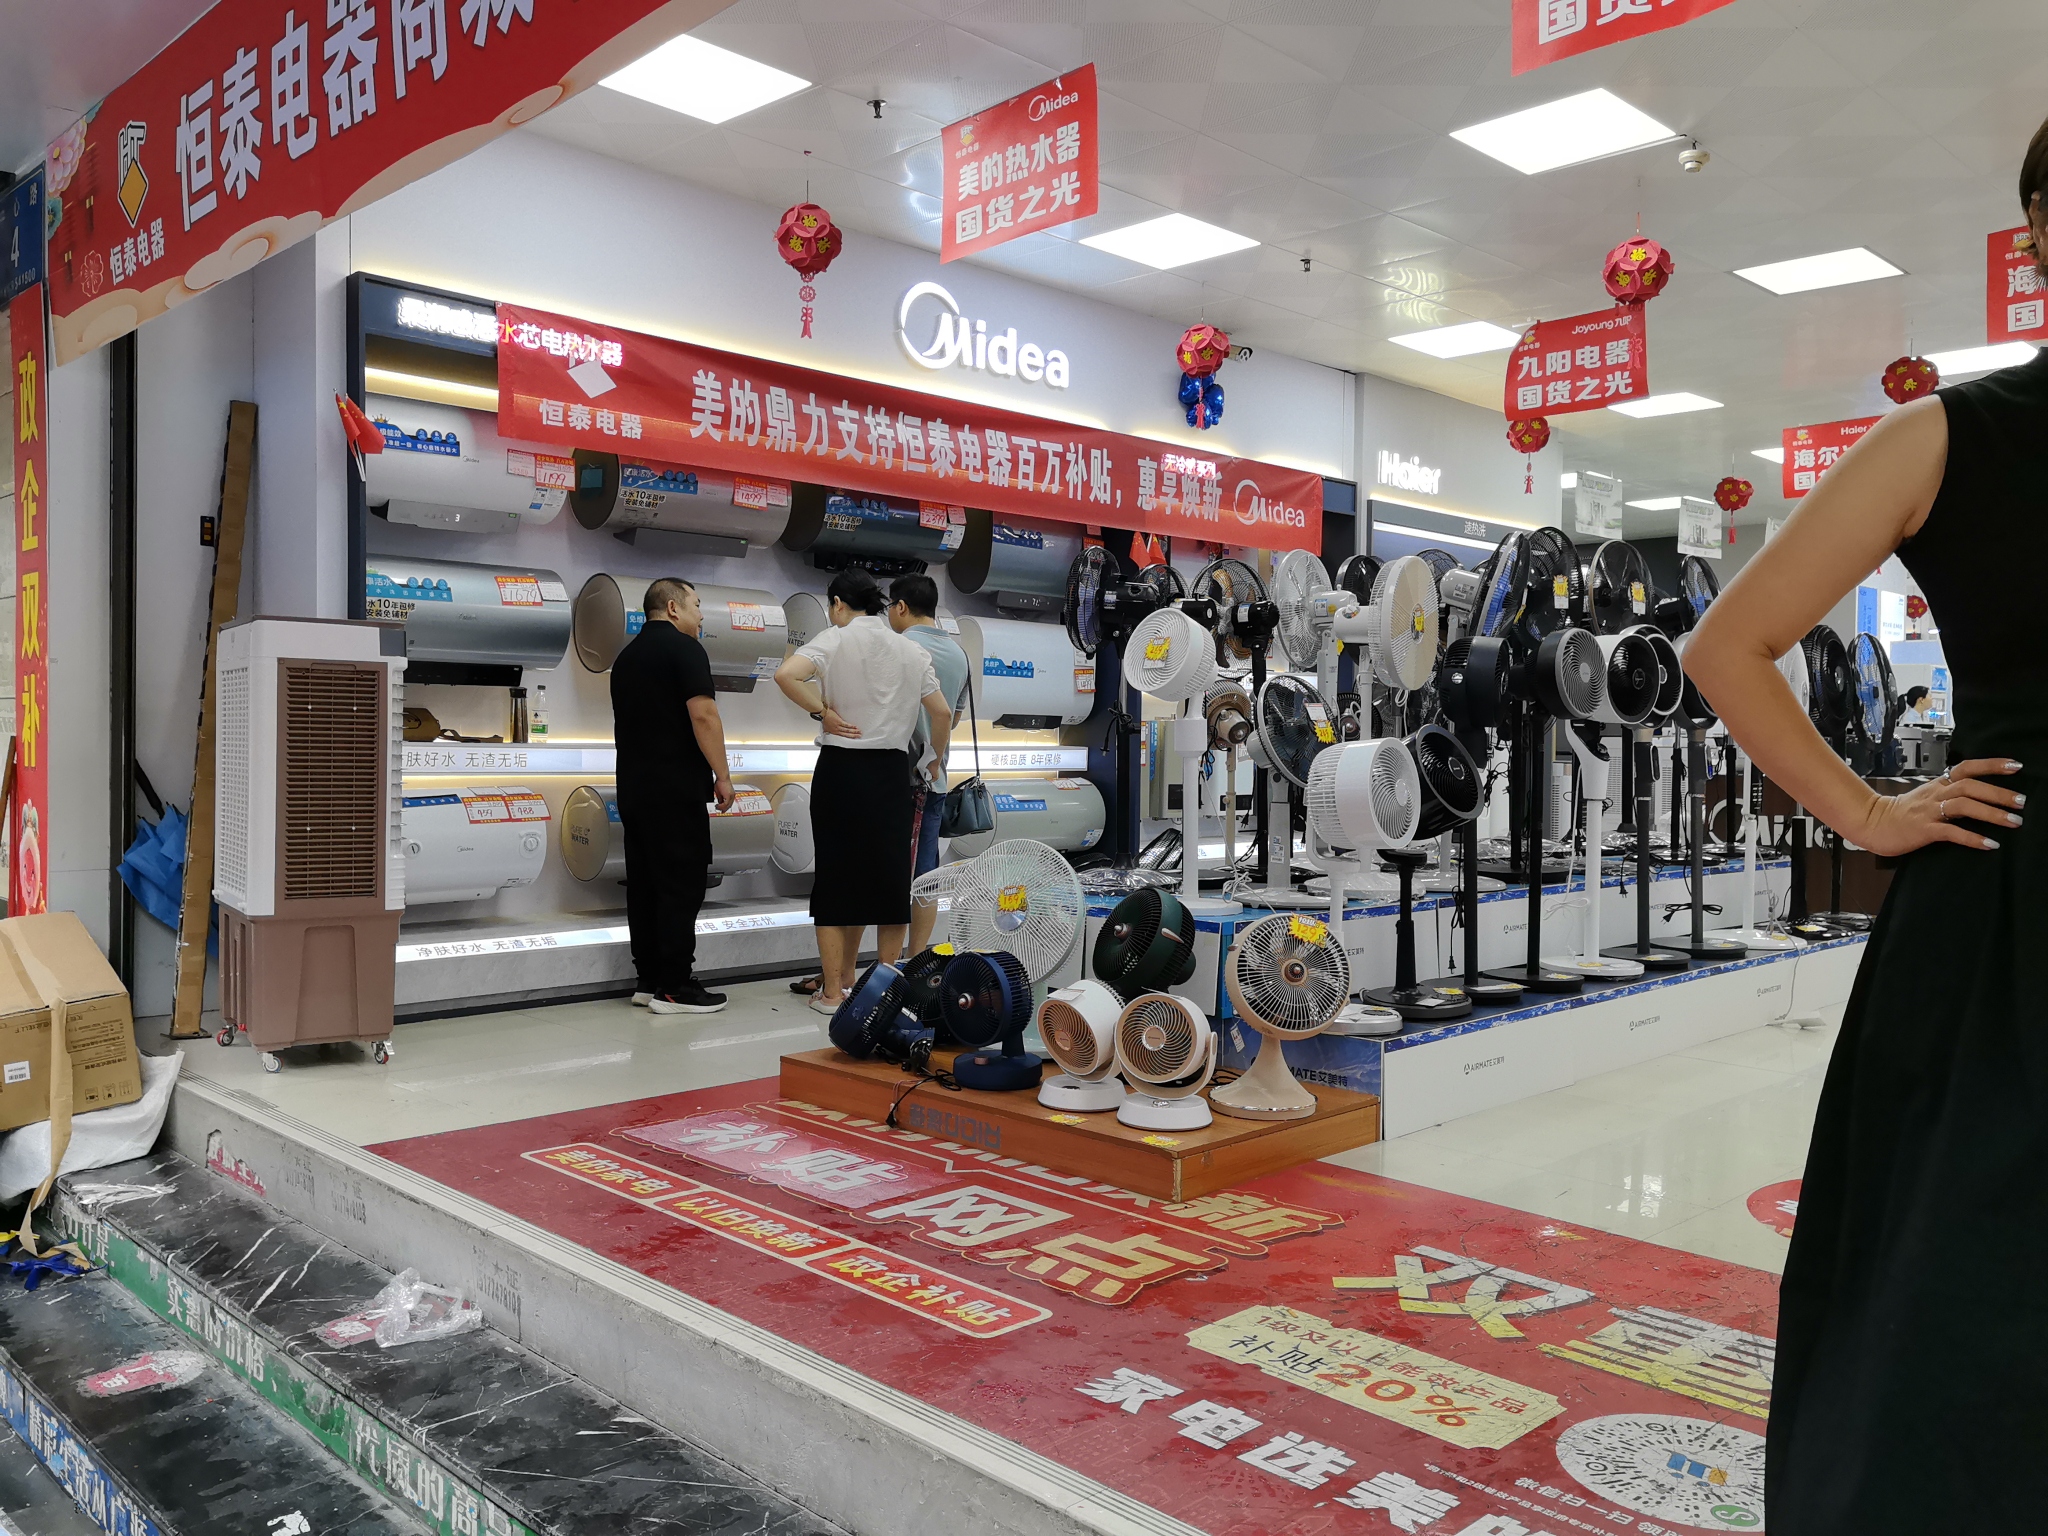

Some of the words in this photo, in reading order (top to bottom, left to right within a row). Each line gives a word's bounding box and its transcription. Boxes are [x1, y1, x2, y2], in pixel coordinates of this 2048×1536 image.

[1028, 91, 1078, 121] Midea
[958, 122, 1080, 201] 美的热水器
[956, 172, 1080, 244] 国货之光
[109, 220, 165, 286] 恒泰电器
[901, 282, 1069, 388] Midea
[1572, 319, 1613, 335] Joyoung
[1517, 338, 1630, 381] 九阳电器
[1517, 371, 1633, 411] 国货之光
[539, 399, 643, 440] 恒泰电器
[1840, 424, 1868, 437] Haier
[1378, 450, 1441, 495] Haier
[1794, 445, 1853, 469] 海尔
[1233, 479, 1306, 527] Midea
[18, 350, 40, 769] 政企双补
[465, 752, 528, 768] 无渣无垢
[991, 754, 1027, 766] 硬核品质
[1030, 753, 1062, 766] 8年保修
[571, 835, 590, 845] WATER
[779, 828, 798, 838] WATER
[722, 915, 776, 930] 安全无忧
[1297, 924, 1317, 940] 129
[417, 942, 486, 958] 净肤好水
[494, 935, 558, 952] 无渣无垢
[546, 1149, 674, 1195] 美的家电
[673, 1196, 827, 1253] 以旧换新
[826, 1253, 1010, 1326] 政企补贴
[1229, 1333, 1473, 1429] 补贴20%
[1257, 1313, 1531, 1416] 1级及以上能效产品
[1514, 1476, 1636, 1523] 微信扫一扫
